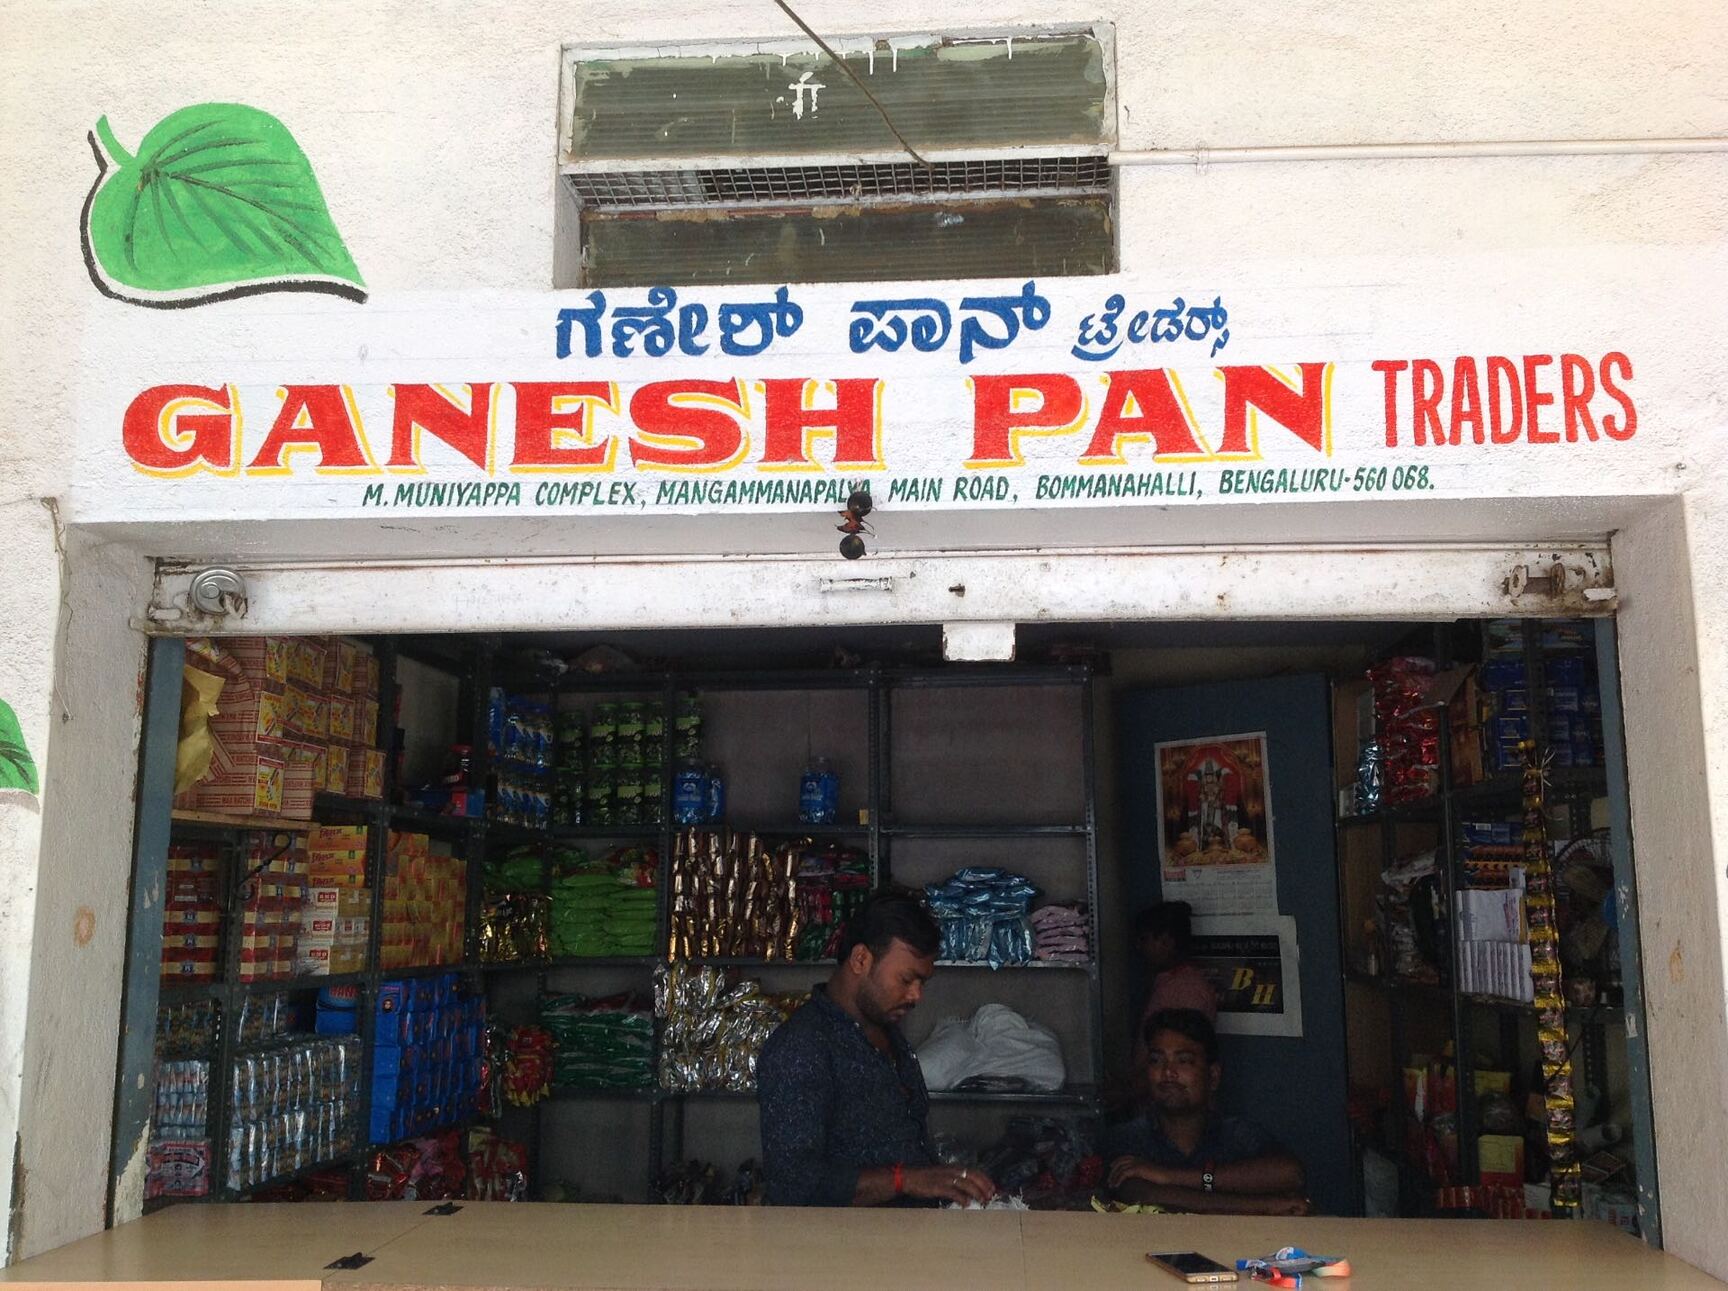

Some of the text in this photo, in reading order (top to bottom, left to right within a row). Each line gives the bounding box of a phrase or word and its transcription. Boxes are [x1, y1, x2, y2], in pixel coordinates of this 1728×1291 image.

[555, 285, 804, 359] ಗಣೇಶ್
[849, 280, 1052, 364] ಪಾನ್
[123, 351, 1638, 476] GANESH PAN TRADERS
[535, 481, 646, 509] COMPLEX,
[888, 477, 943, 502] MAIN
[953, 476, 1018, 503] ROAD,
[1036, 471, 1202, 500] BOMMANAHALLI,
[1392, 465, 1435, 490] 068.
